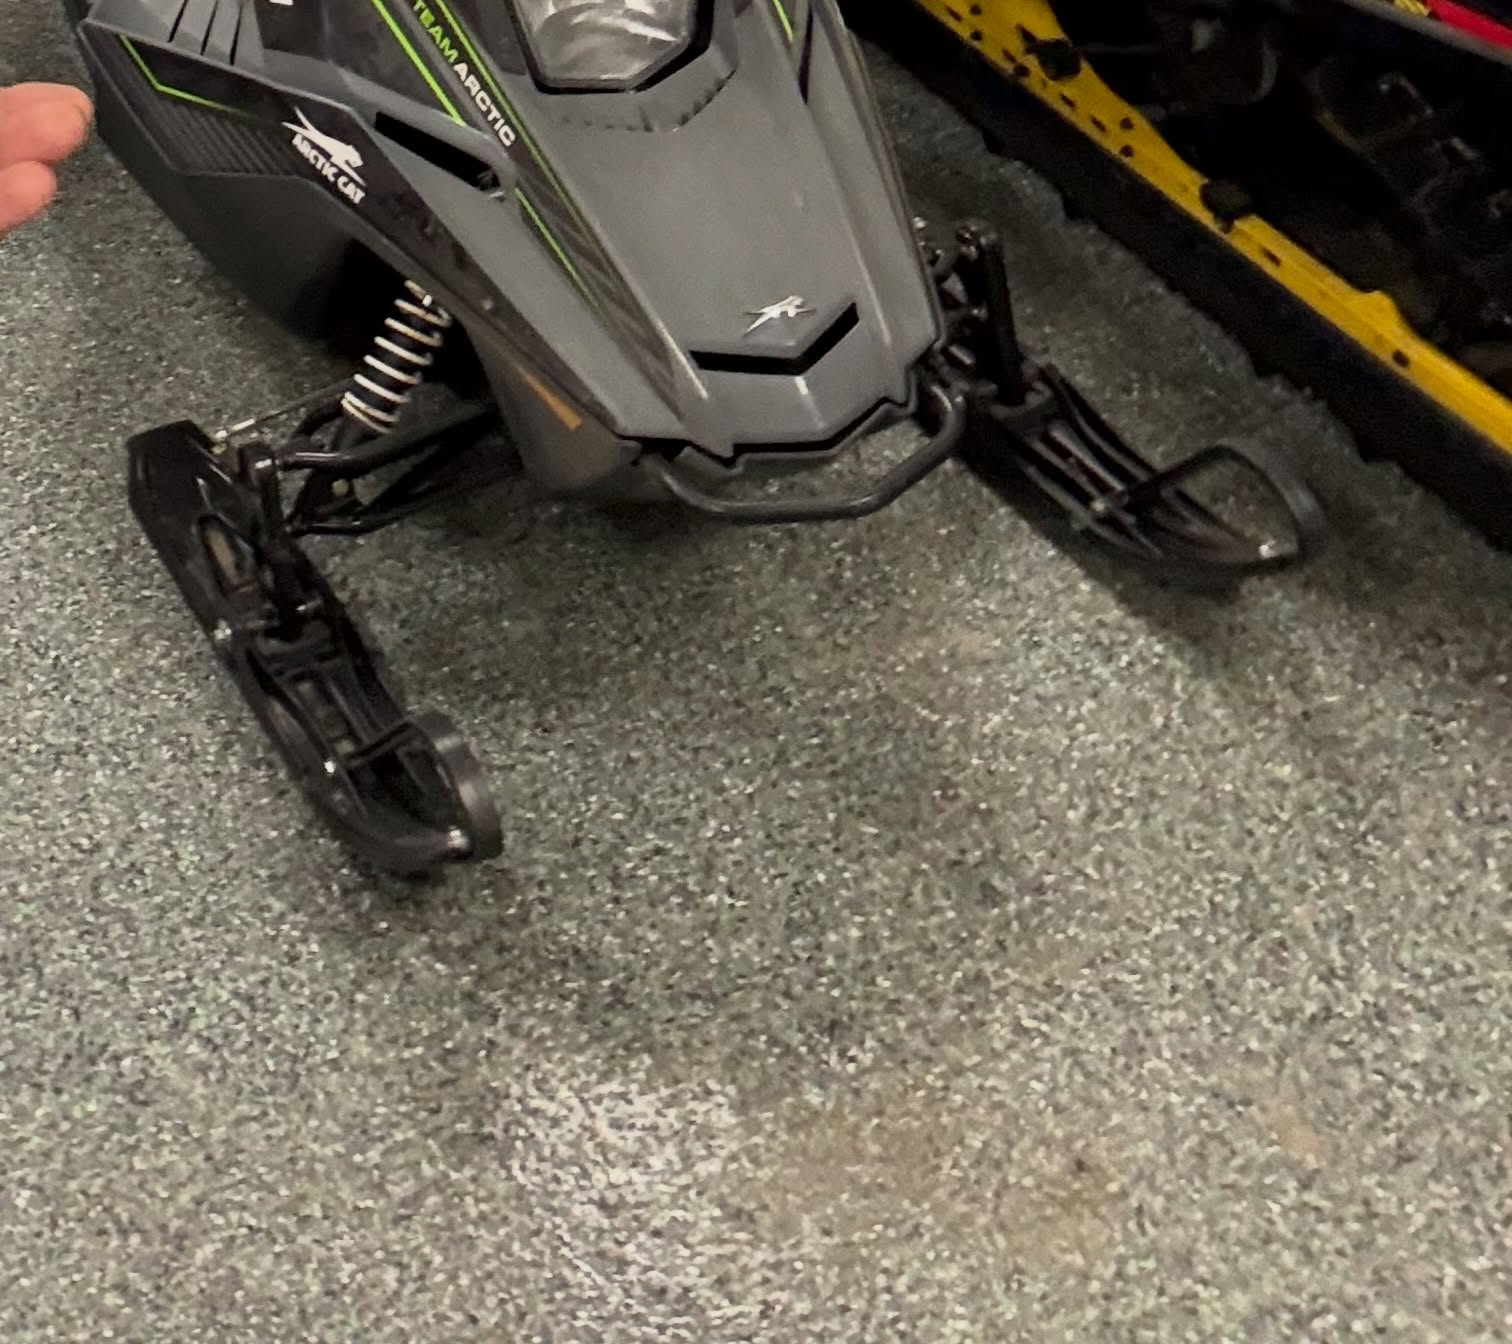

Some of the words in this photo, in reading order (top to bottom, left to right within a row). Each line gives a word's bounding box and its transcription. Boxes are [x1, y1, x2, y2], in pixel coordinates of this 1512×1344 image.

[453, 62, 516, 147] ARCTIC
[291, 133, 339, 182] ARCTIC
[336, 175, 366, 205] CAT
